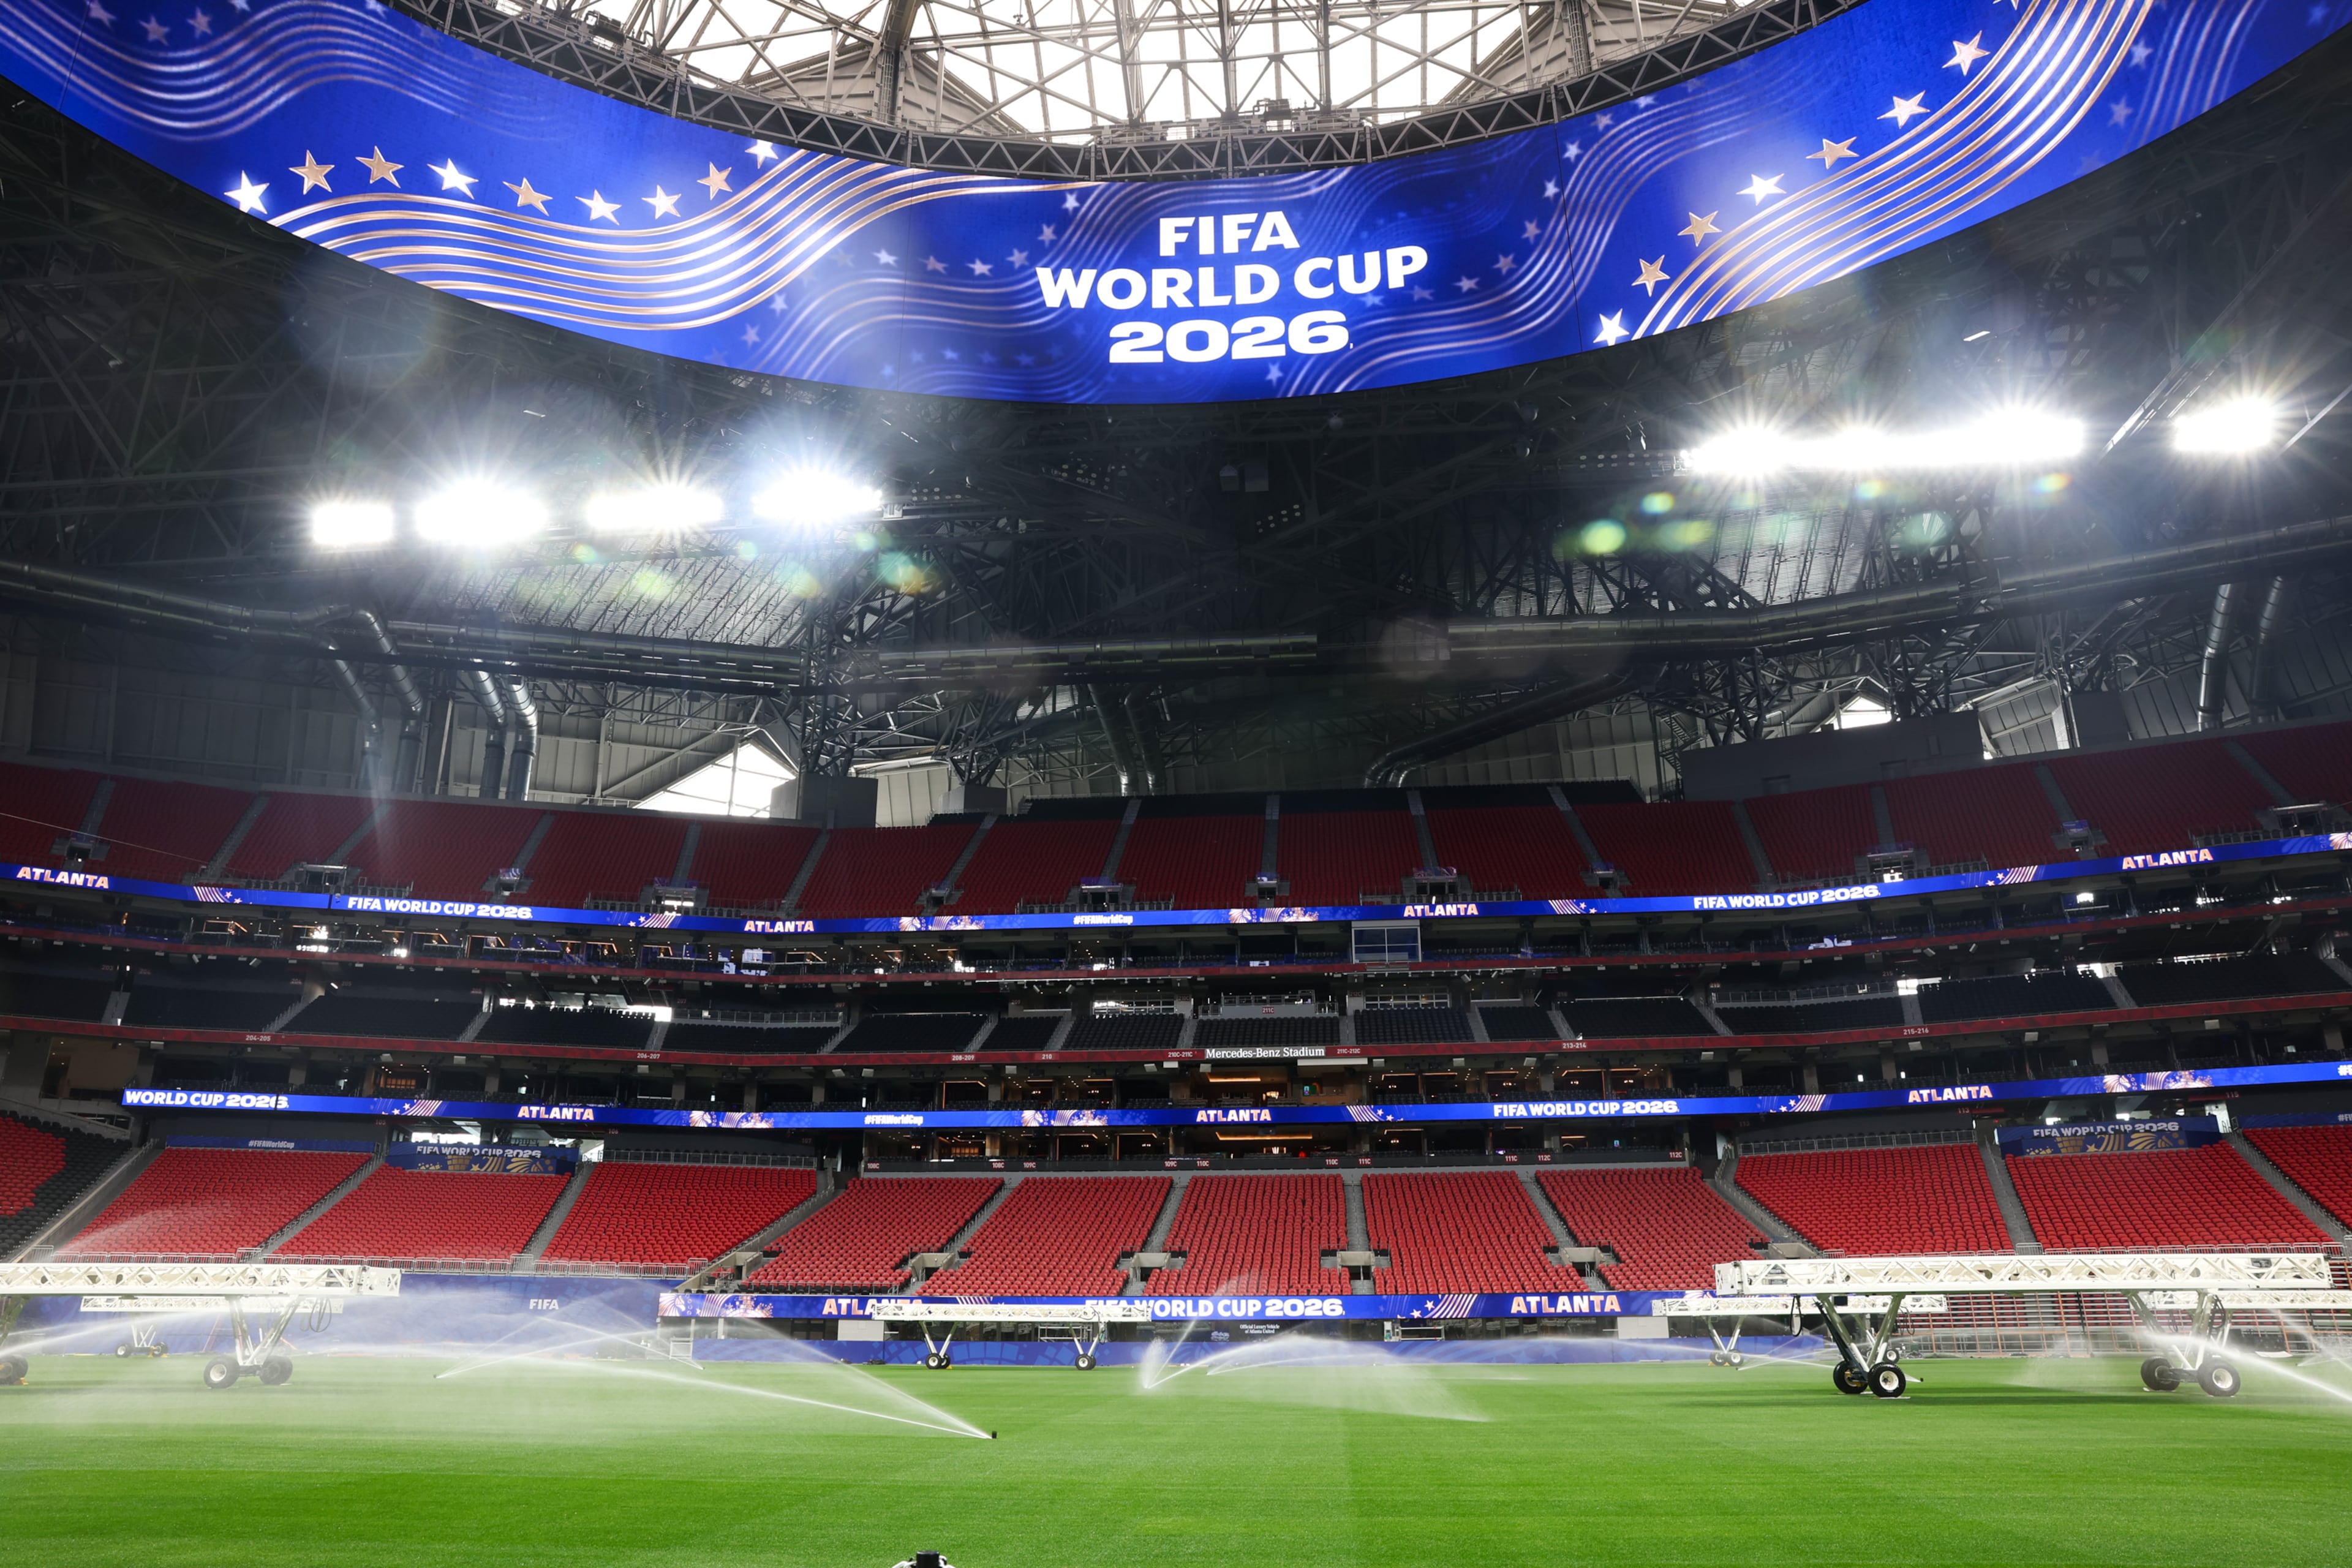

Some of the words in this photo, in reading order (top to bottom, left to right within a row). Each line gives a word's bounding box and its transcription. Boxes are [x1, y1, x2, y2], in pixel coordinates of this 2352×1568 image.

[1159, 211, 1300, 257] FIFA
[1036, 263, 1280, 309] WORLD
[1294, 245, 1428, 300] CUP
[1109, 310, 1349, 363] 2026
[2122, 848, 2214, 870] ATLANTA
[17, 867, 109, 889] ATLANTA
[1694, 897, 1727, 909] FIFA
[1728, 894, 1785, 908] WORLD
[1787, 892, 1819, 906] CUP
[1822, 885, 1879, 902] 2026
[348, 897, 381, 910] FIFA
[385, 899, 441, 913] WORLD
[443, 903, 475, 916] CUP
[477, 905, 532, 919] 2026
[1403, 903, 1479, 918] ATLANTA
[744, 920, 814, 933] ATLANTA
[1073, 914, 1133, 925] #FIFAWorldCup
[1206, 1047, 1280, 1058] Mercedes-Benz
[1283, 1047, 1325, 1057] Stadium
[125, 1091, 188, 1105] WORLD
[189, 1093, 224, 1106] CUP
[1908, 1085, 1993, 1103] ATLANTA
[518, 1106, 594, 1121] ATLANTA
[1196, 1109, 1272, 1122] ATLANTA
[1494, 1104, 1528, 1117] FIFA
[1529, 1102, 1586, 1116] WORLD
[1588, 1102, 1620, 1115] CUP
[1622, 1101, 1678, 1114] 2026
[864, 1114, 924, 1126] #FIFAWorldCup
[2034, 1128, 2060, 1137] FIFA
[2135, 1121, 2179, 1133] 2026
[248, 1140, 295, 1150] #FIFAWorldCup
[417, 1145, 439, 1155] FIFA
[504, 1149, 541, 1159] 2026
[529, 1298, 559, 1310] FIFA
[823, 1298, 922, 1315] ATLA
[1218, 1299, 1262, 1317] CUP
[1265, 1298, 1343, 1316] 2026
[1510, 1295, 1621, 1314] ATLANTA
